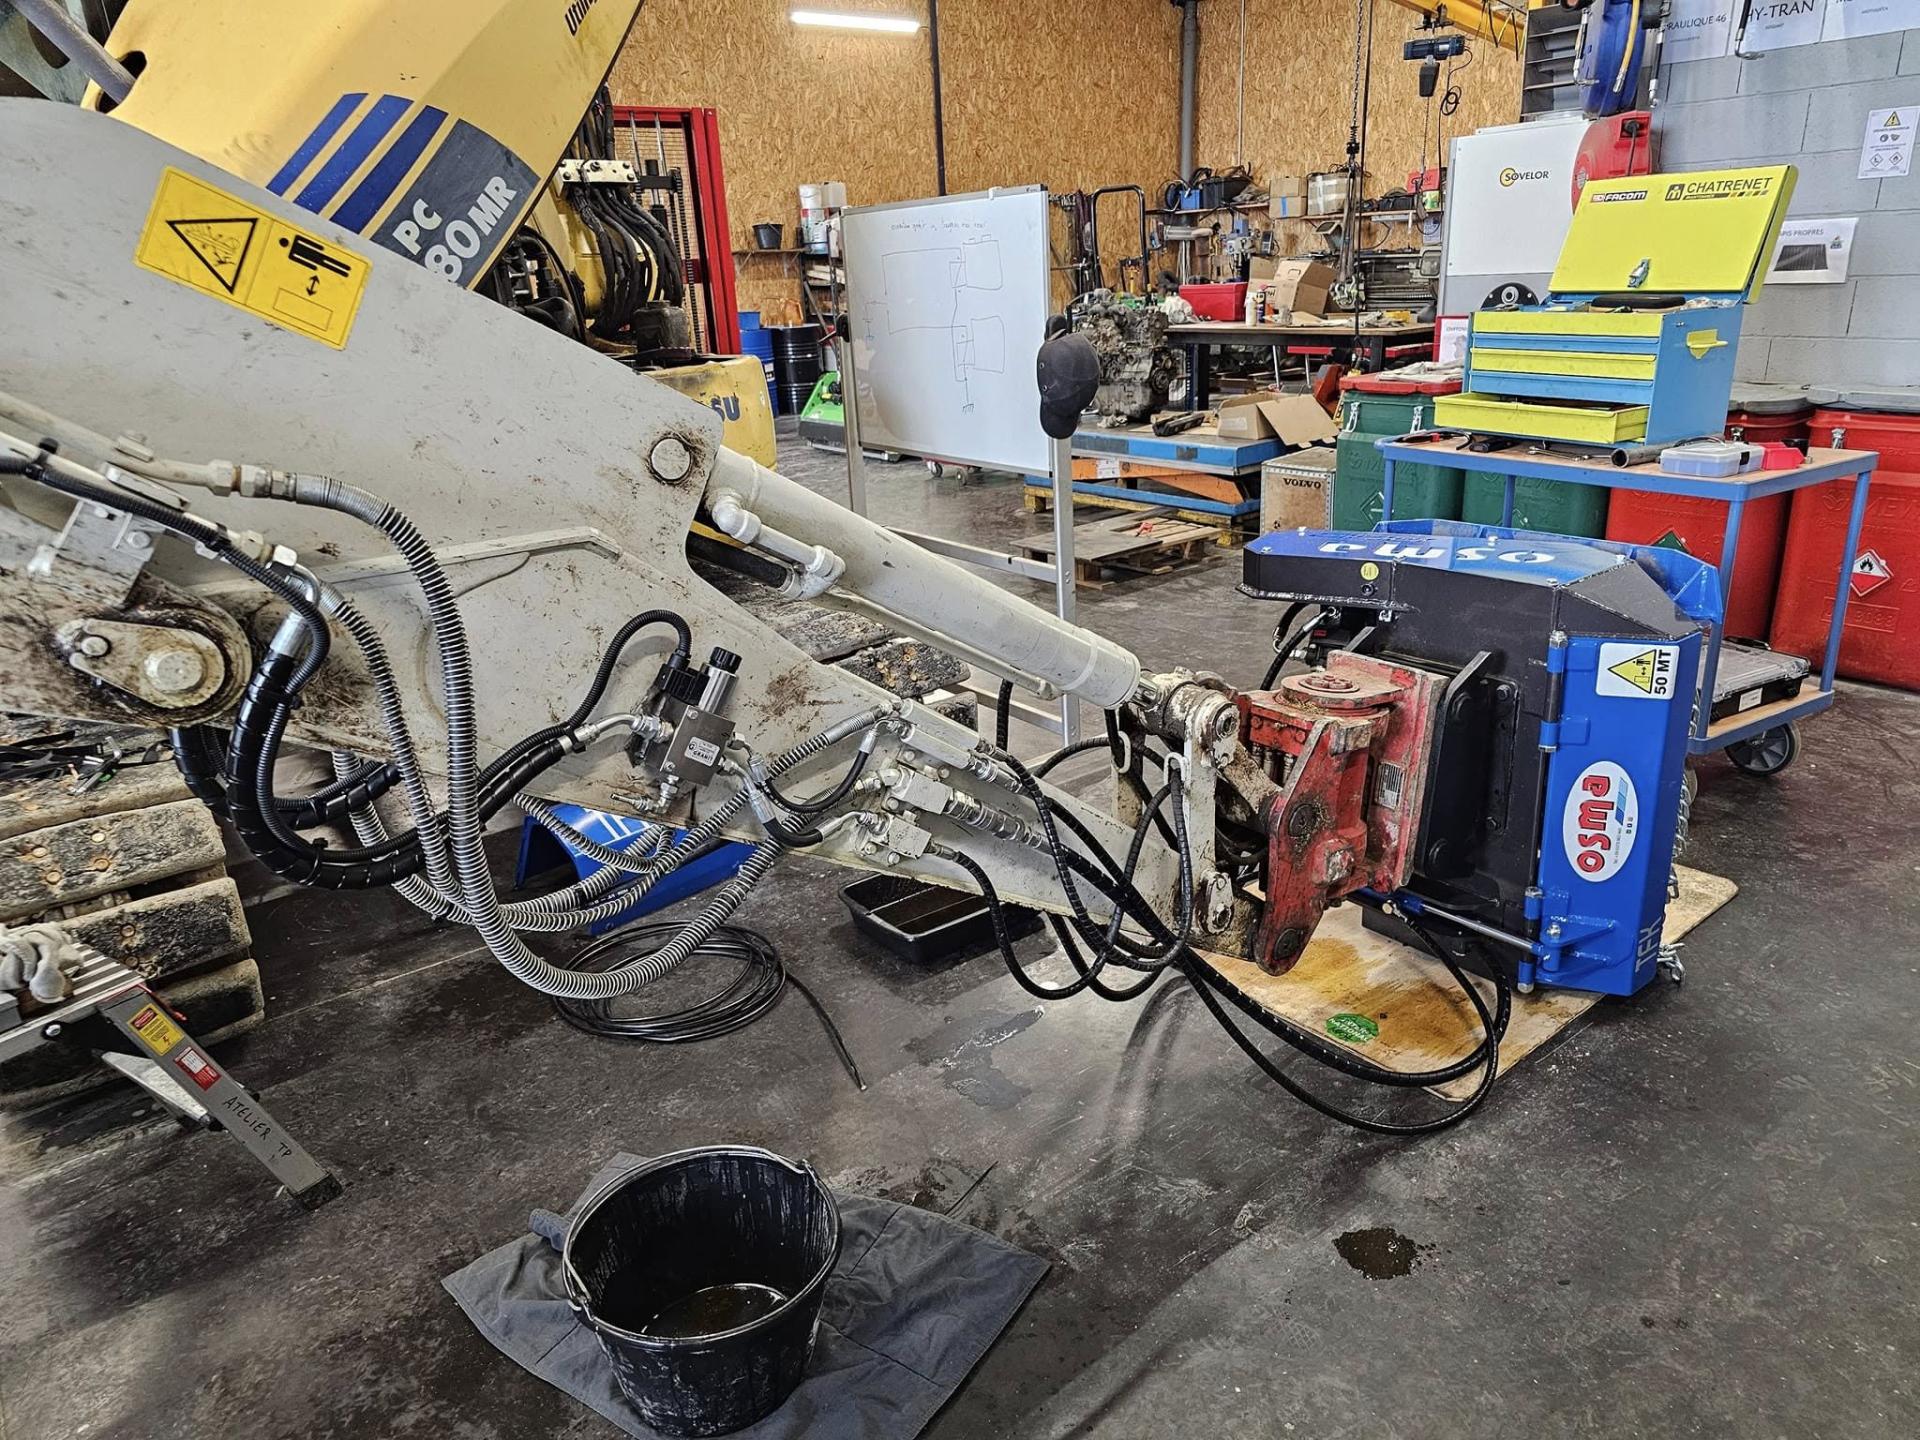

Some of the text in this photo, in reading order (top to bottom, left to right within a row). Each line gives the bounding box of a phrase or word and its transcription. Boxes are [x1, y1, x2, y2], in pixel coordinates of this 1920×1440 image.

[1667, 15, 1714, 30] RAULIQUE
[1504, 170, 1550, 182] SOVELOR
[1687, 177, 1774, 193] CHATRENET
[392, 198, 443, 256] PC
[1283, 477, 1322, 489] VOLVO
[1654, 649, 1672, 695] 50 MT
[279, 1142, 292, 1158] TP
